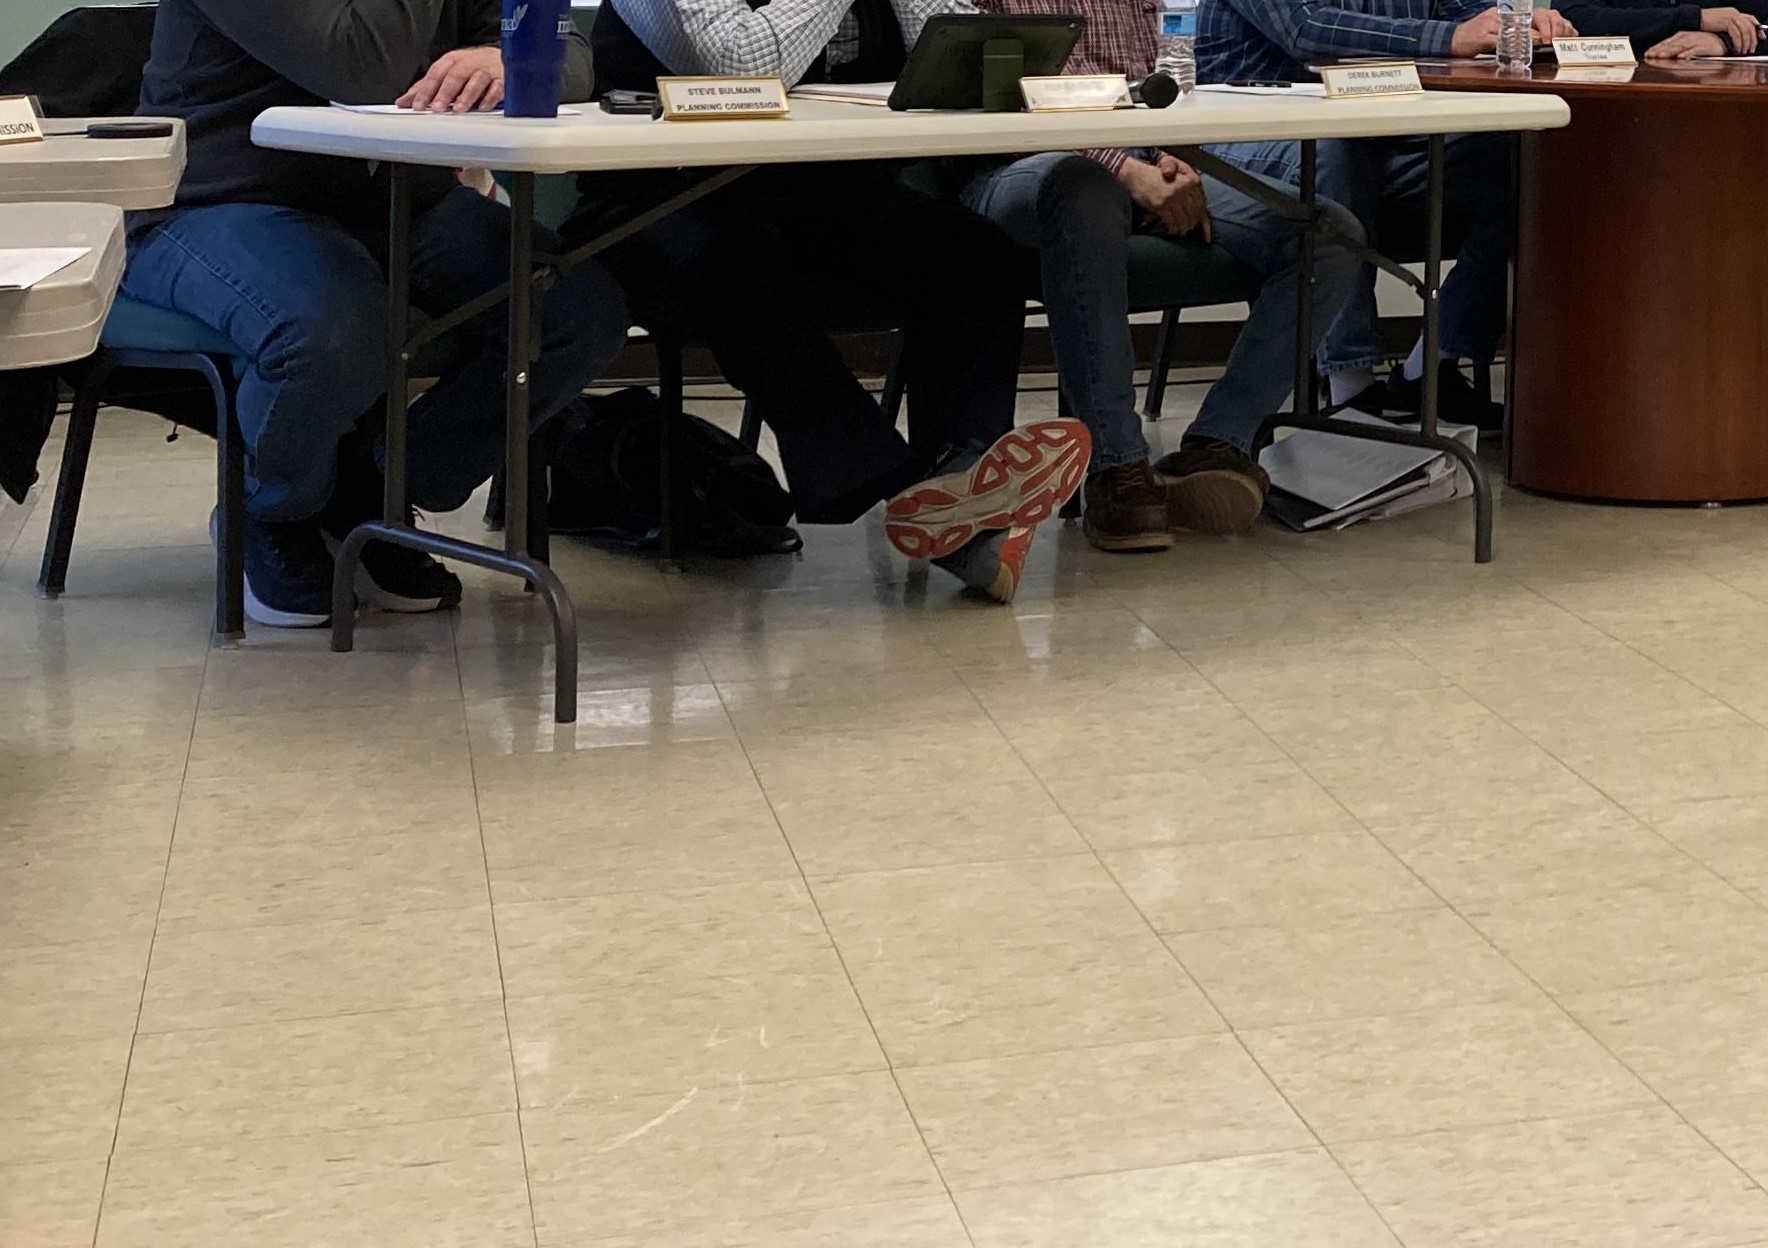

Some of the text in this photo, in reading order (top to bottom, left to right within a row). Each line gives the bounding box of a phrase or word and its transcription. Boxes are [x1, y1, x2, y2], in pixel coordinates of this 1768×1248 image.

[1559, 42, 1626, 53] Matt Cunningham
[1347, 71, 1370, 79] DEREK
[687, 86, 762, 96] STEVE BULMANN
[676, 101, 780, 112] PLANNING COMMISSION
[0, 122, 35, 135] ISSION
